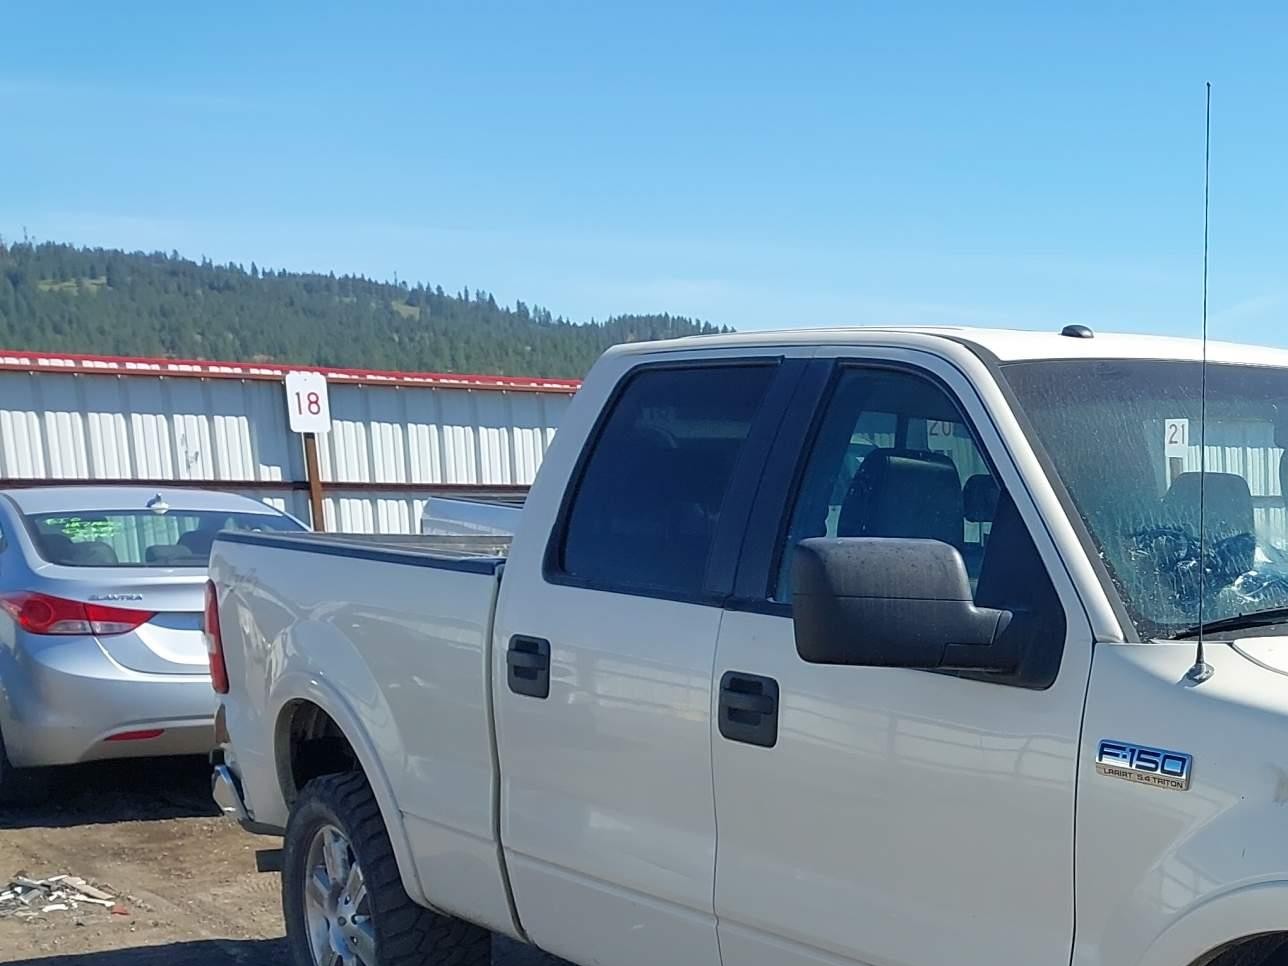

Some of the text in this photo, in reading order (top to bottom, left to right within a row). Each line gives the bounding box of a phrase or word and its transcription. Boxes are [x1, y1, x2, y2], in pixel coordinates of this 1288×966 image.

[296, 391, 321, 415] 18
[1168, 423, 1186, 445] 21
[1098, 742, 1187, 777] F-150
[1103, 767, 1133, 779] LARIAT
[1152, 776, 1184, 789] TRITON
